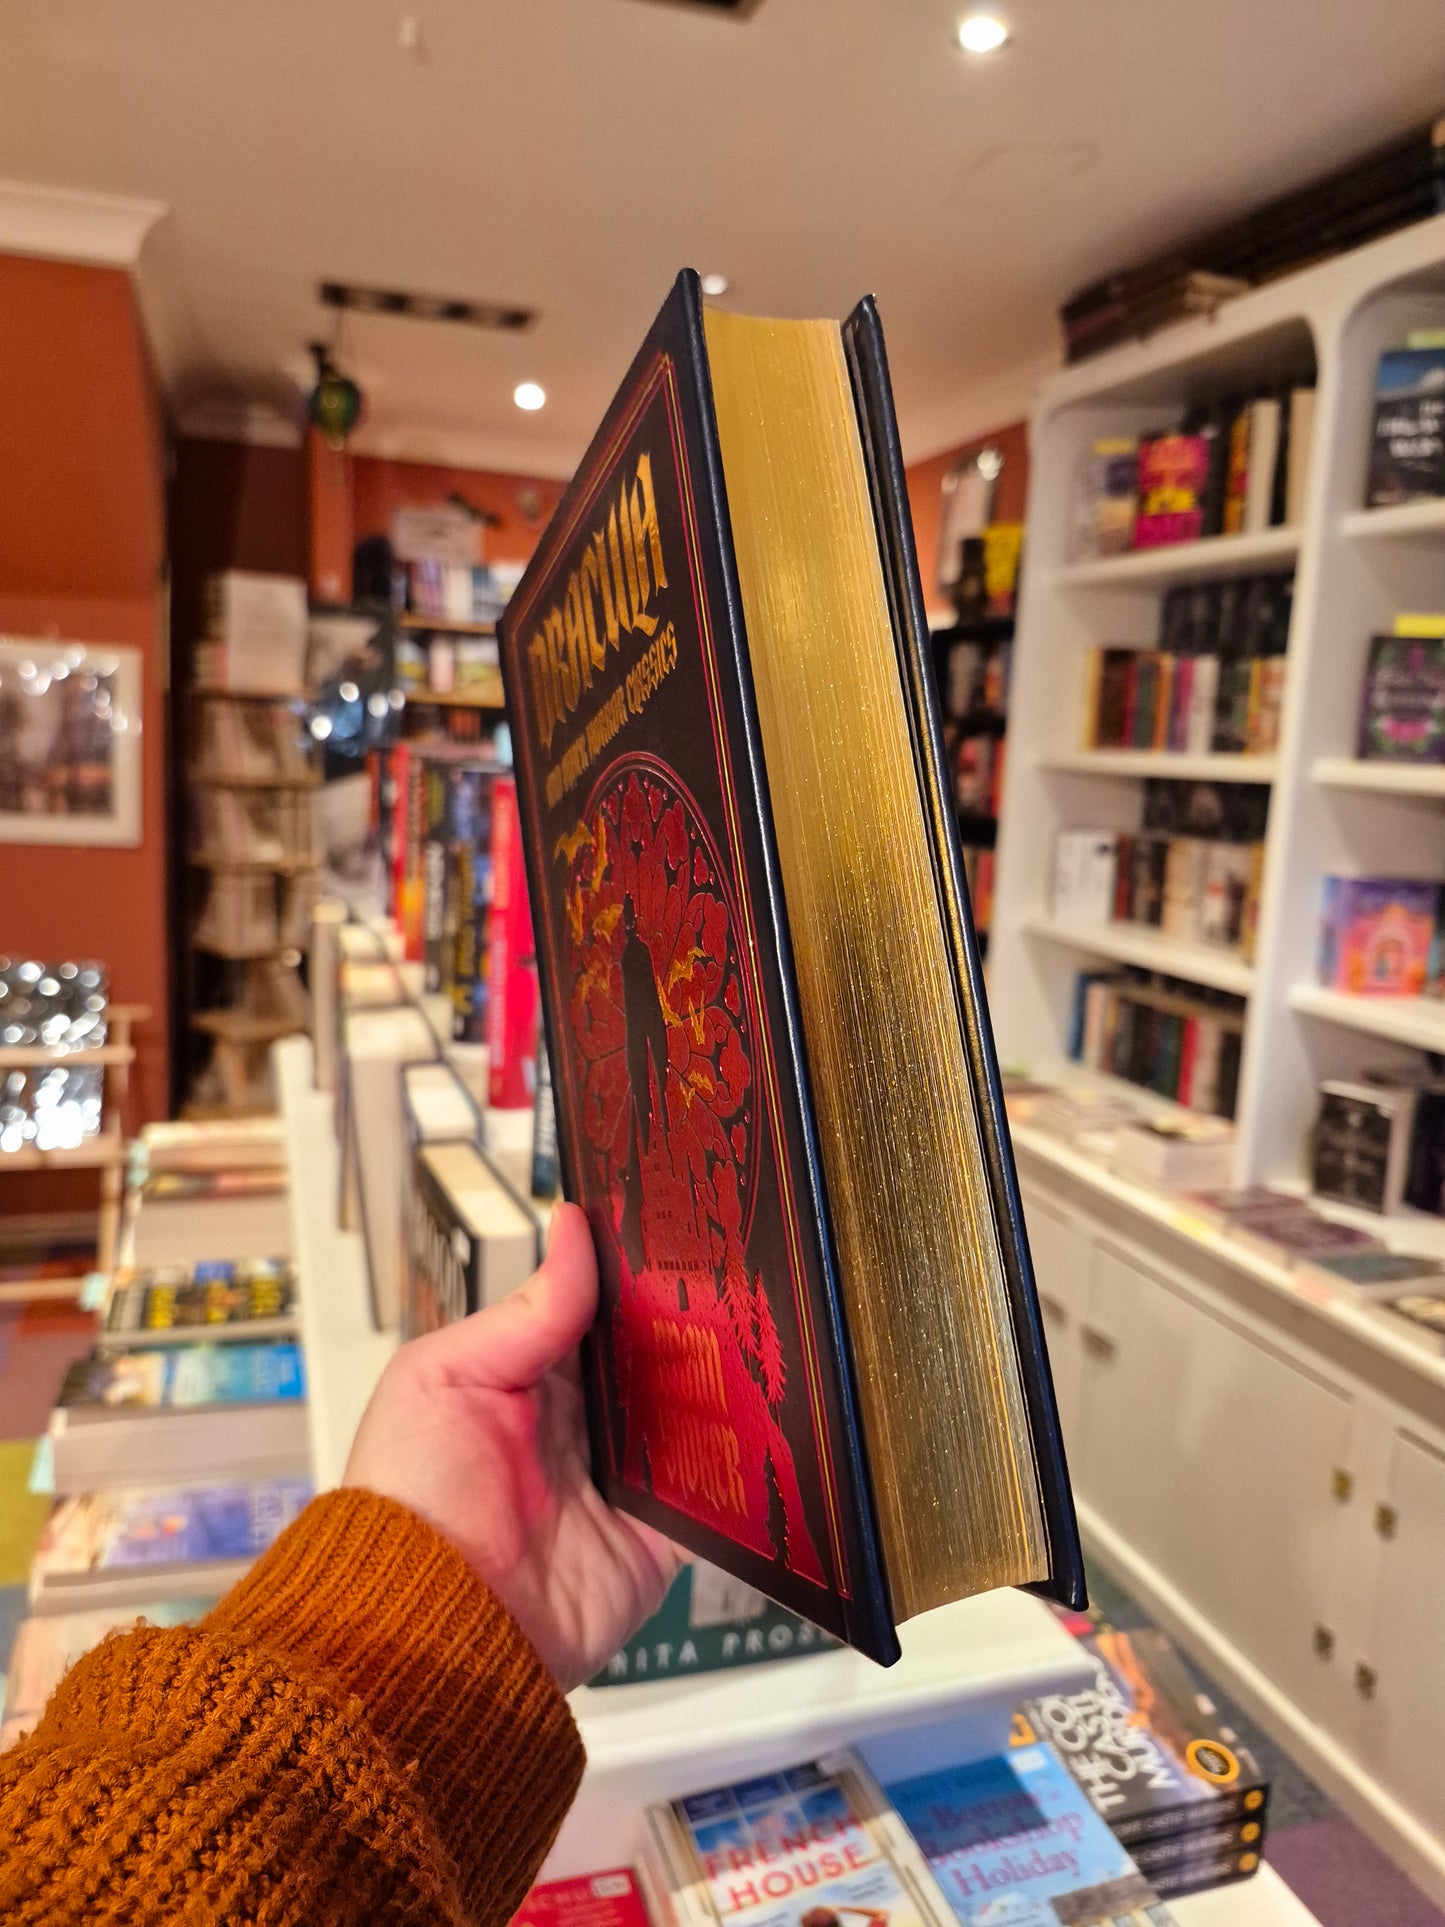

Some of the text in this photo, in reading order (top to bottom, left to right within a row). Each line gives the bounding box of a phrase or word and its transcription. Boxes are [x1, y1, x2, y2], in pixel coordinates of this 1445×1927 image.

[527, 451, 668, 754] DRACULA
[626, 620, 678, 715] CLASSICS
[606, 1620, 838, 1678] NITA PROS
[703, 1810, 864, 1881] FRENCH
[728, 1842, 870, 1912] HOUSE
[951, 1848, 1082, 1898] Holiday
